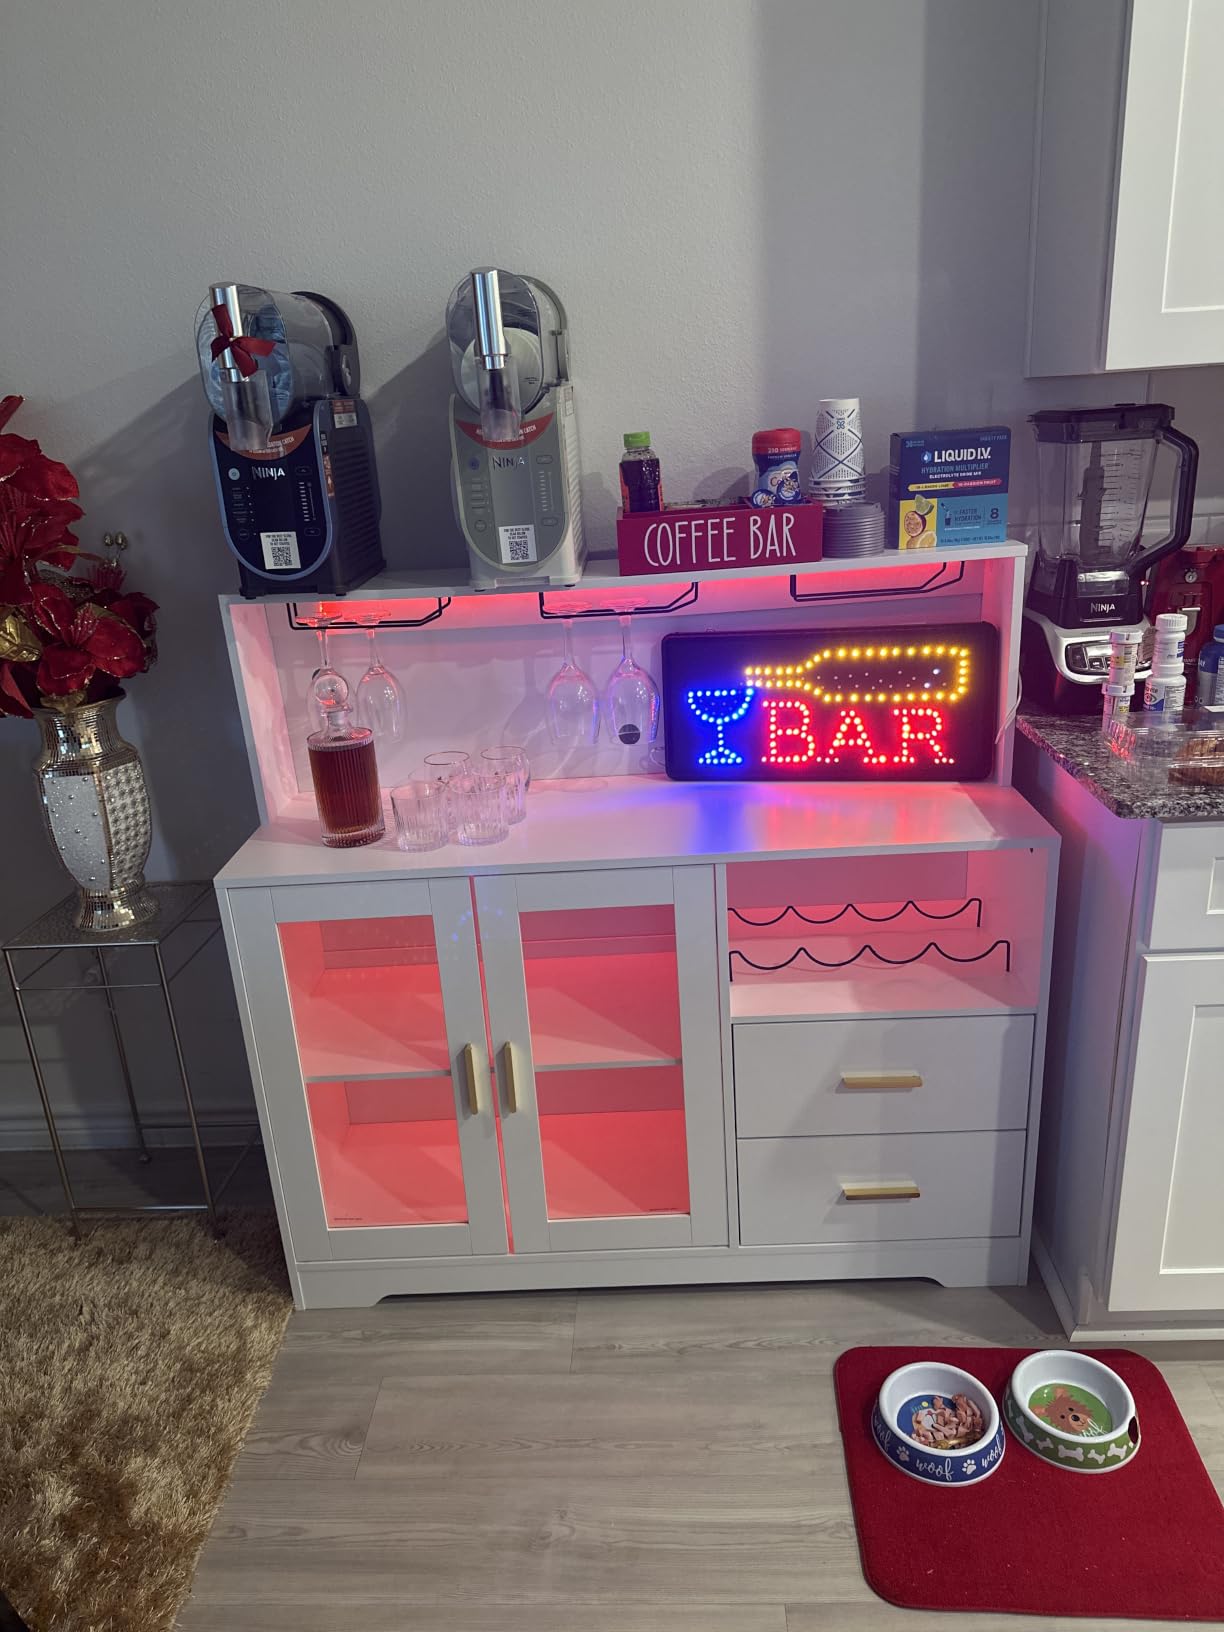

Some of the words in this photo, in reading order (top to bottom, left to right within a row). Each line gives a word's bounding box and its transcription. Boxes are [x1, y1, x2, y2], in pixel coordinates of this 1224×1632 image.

[934, 448, 976, 463] LIQUID
[977, 447, 992, 460] I.V.
[493, 456, 525, 471] NINJA
[921, 464, 955, 474] HYDRATION
[955, 462, 989, 472] MULTIPLIER
[252, 466, 285, 481] NINJA
[990, 507, 999, 519] 8
[644, 517, 736, 566] COFFEE
[750, 512, 797, 560] BAR
[1090, 602, 1116, 613] NINJA
[760, 700, 956, 765] BAR
[915, 1457, 955, 1482] woof
[981, 1433, 1003, 1469] woof
